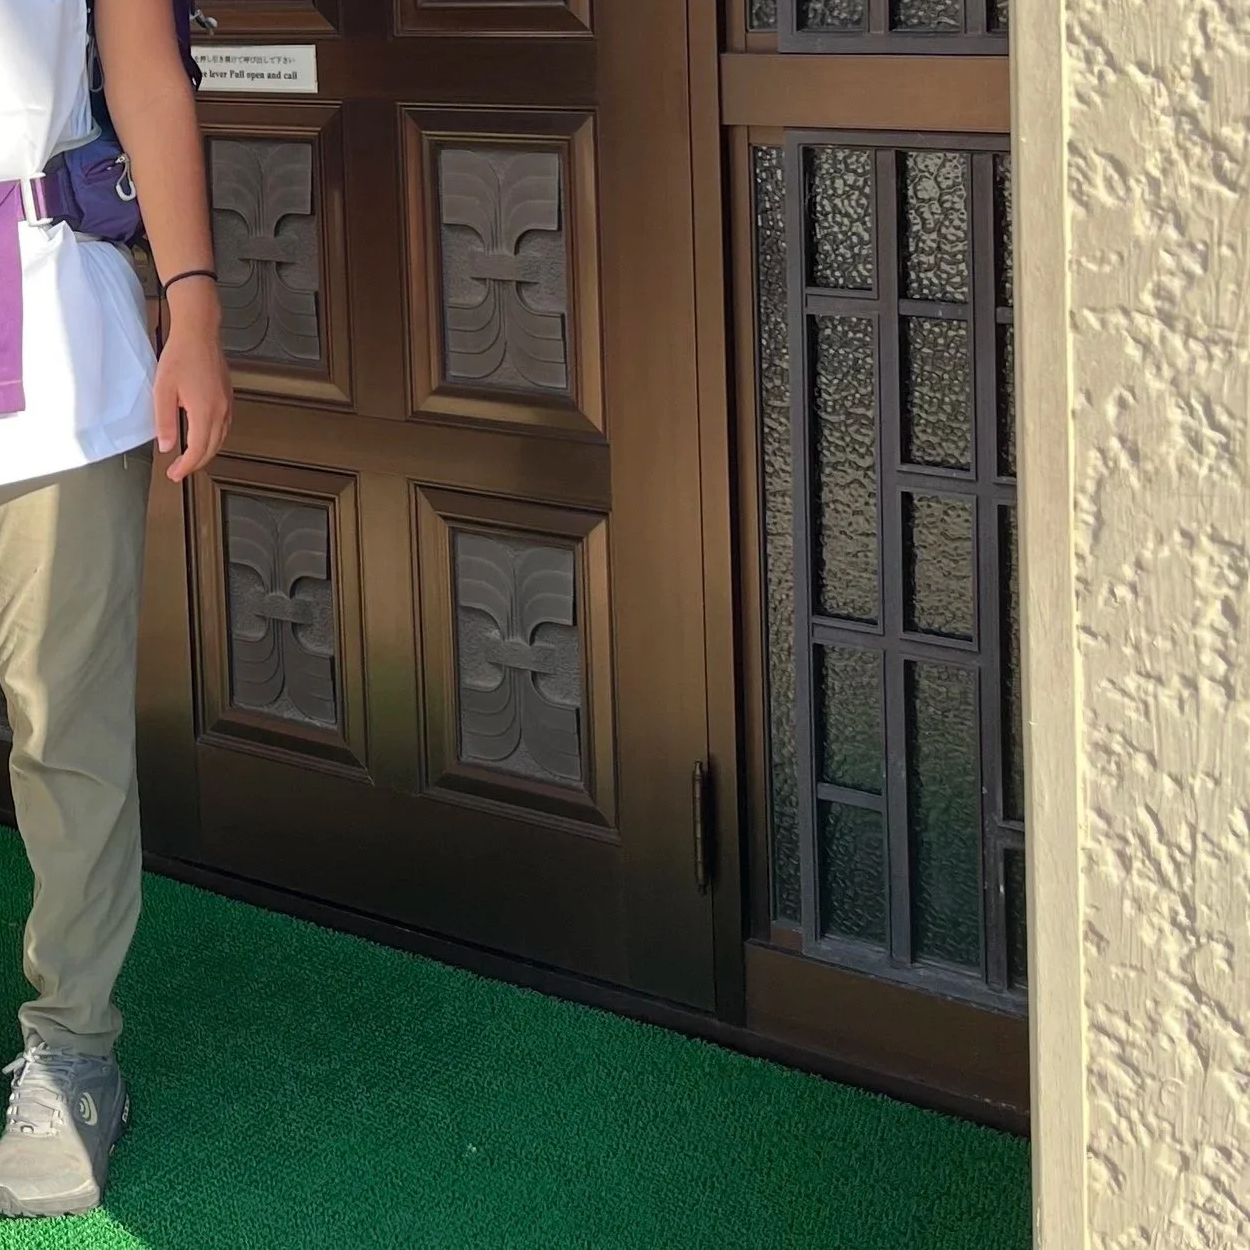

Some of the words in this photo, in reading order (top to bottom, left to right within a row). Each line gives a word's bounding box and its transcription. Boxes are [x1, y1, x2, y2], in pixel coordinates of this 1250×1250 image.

[209, 69, 228, 78] lever
[229, 69, 245, 79] Pull
[246, 71, 265, 81] open
[267, 70, 282, 79] and
[283, 71, 298, 80] call
